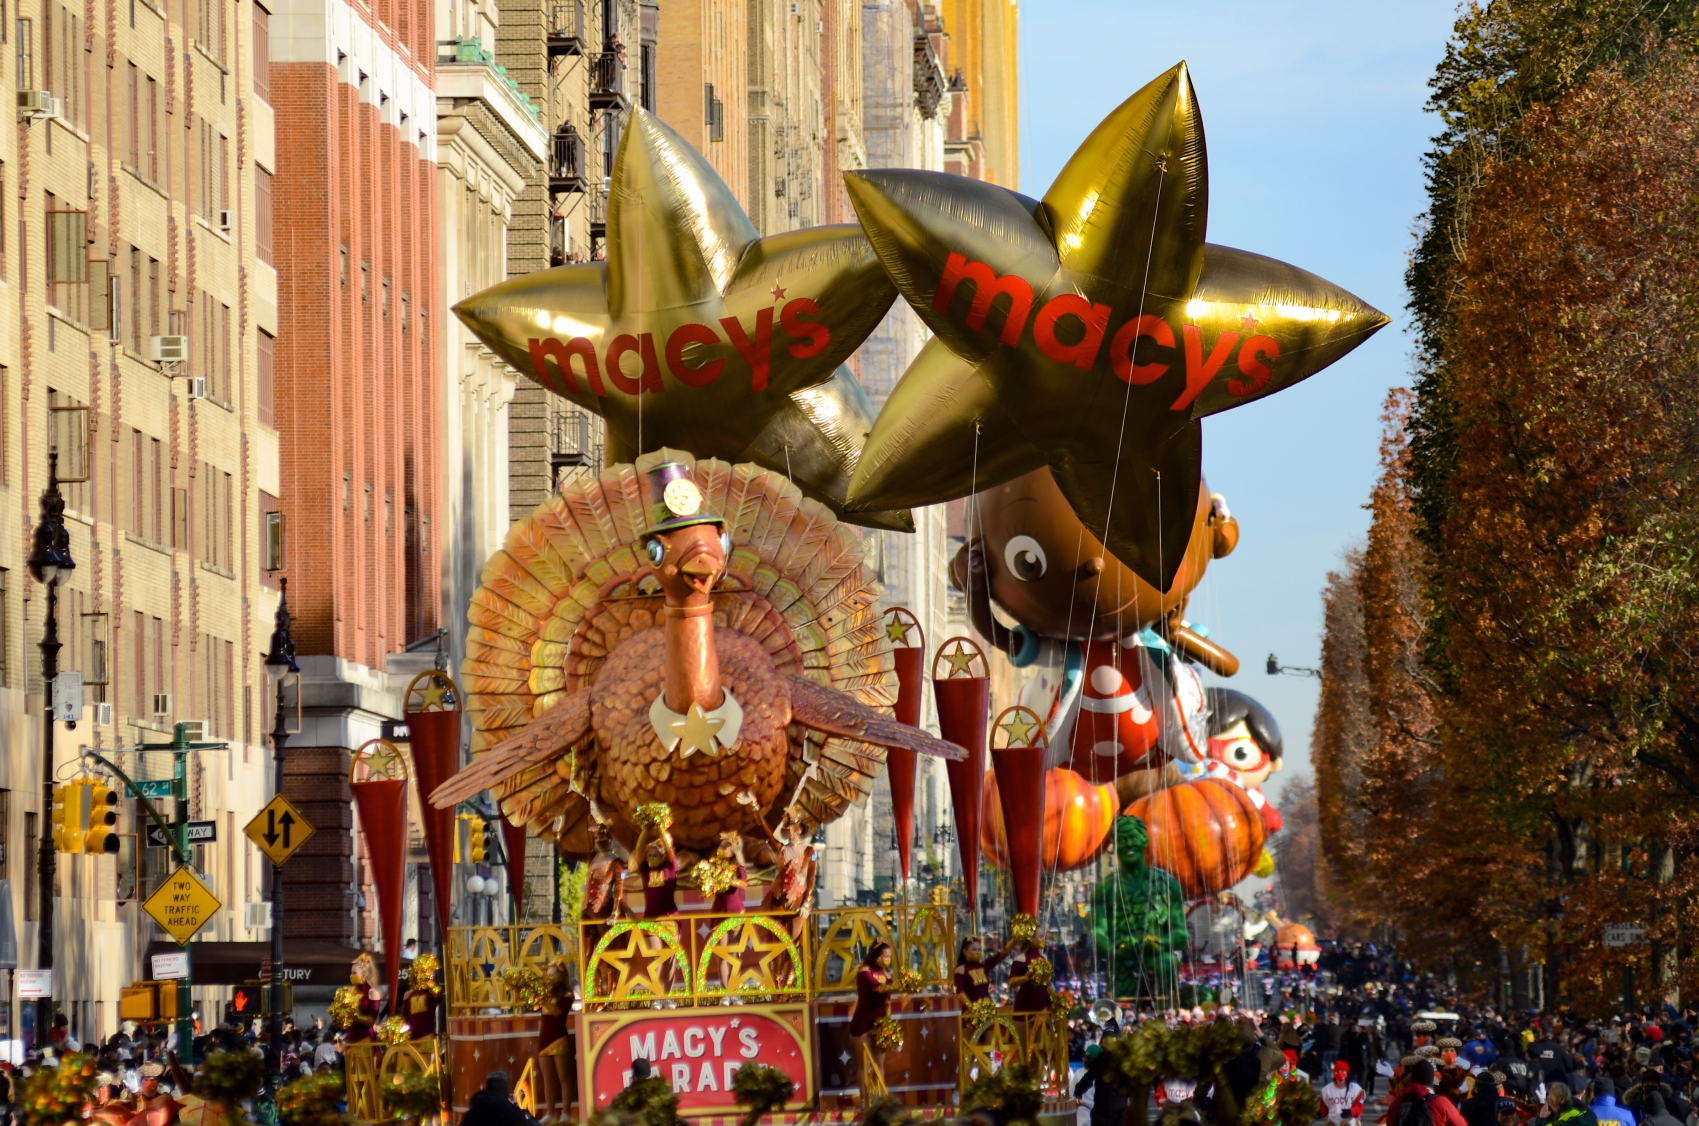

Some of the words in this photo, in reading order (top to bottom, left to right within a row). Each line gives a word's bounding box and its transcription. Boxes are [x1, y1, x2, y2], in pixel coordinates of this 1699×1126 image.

[142, 782, 157, 796] 62
[158, 829, 176, 840] OE
[187, 828, 208, 838] WAY
[173, 882, 191, 891] TWO
[173, 893, 190, 902] WAY
[164, 905, 200, 915] TRAFFIC
[167, 917, 197, 926] AHEAD
[1509, 1062, 1527, 1076] NYPD
[622, 1061, 768, 1094] PRAD
